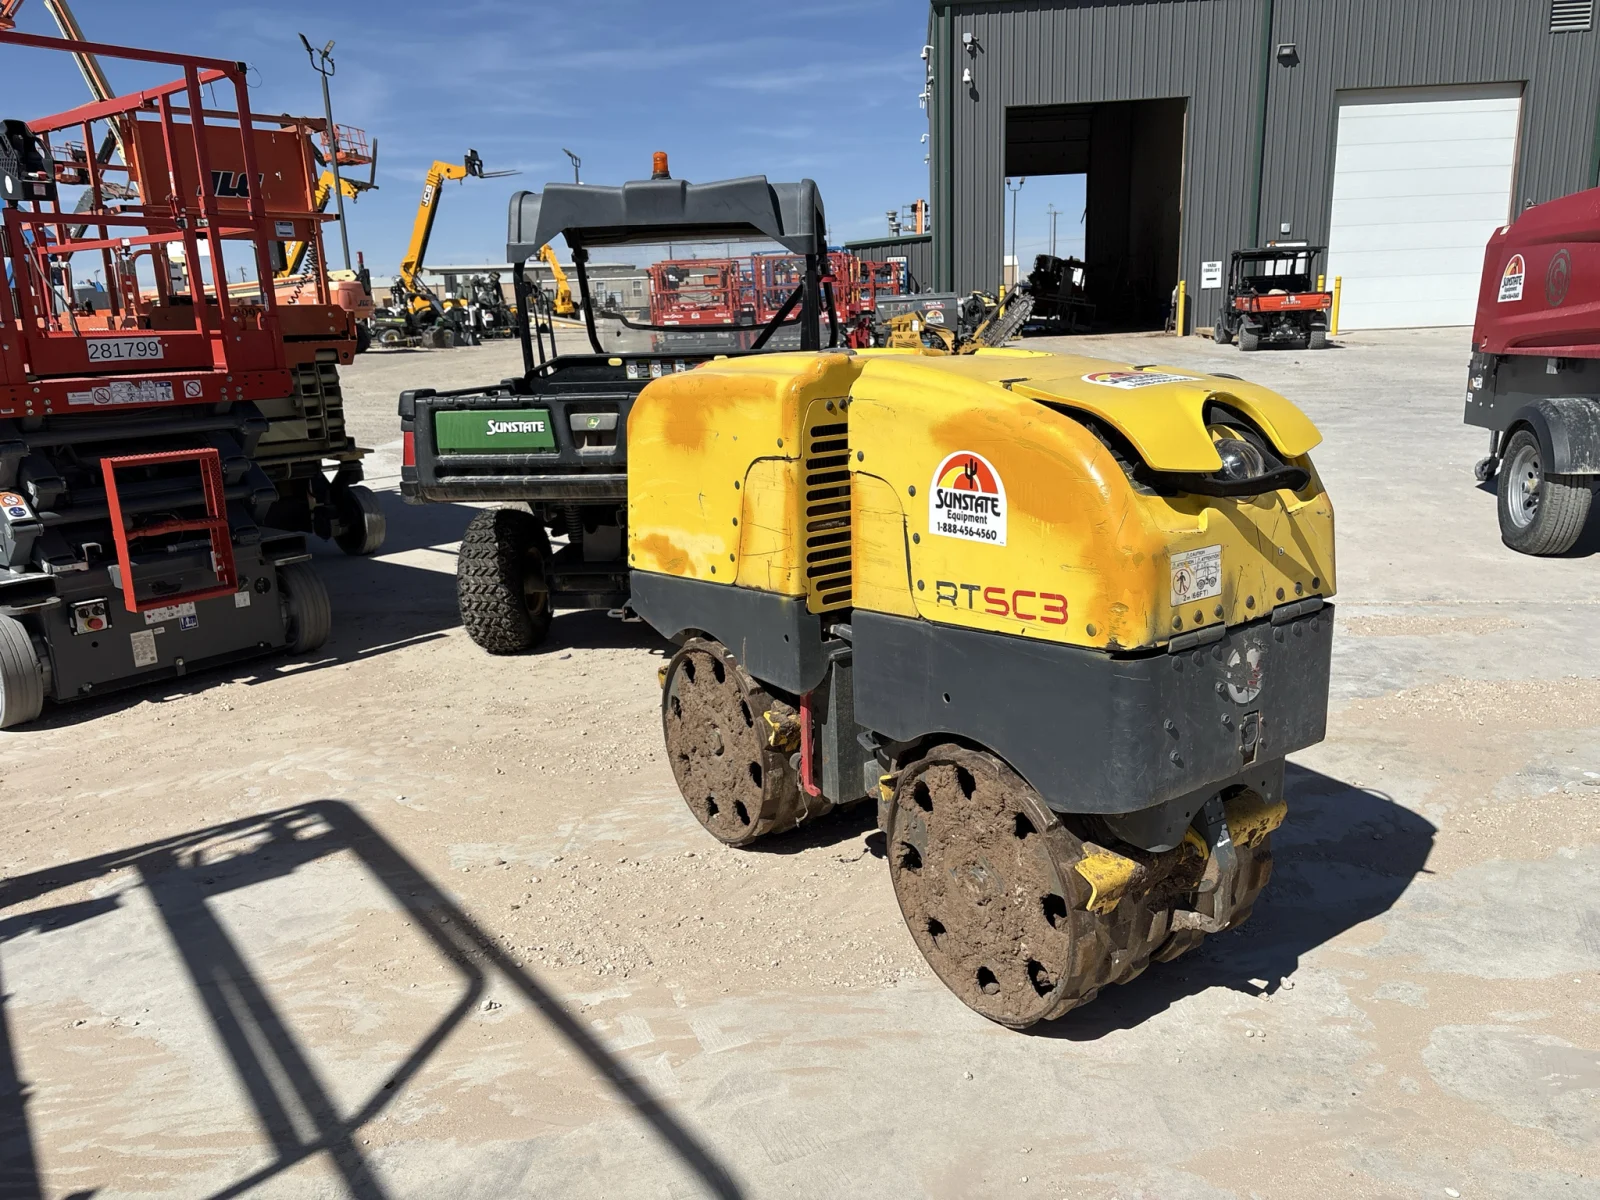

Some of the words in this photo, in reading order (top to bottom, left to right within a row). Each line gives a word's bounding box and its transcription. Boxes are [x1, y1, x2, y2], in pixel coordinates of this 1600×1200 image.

[421, 184, 433, 207] JCB
[88, 341, 159, 359] 281799
[486, 420, 545, 435] SUNSTATE
[935, 488, 1001, 517] SUNSTATE
[947, 509, 988, 524] Equipment
[937, 522, 997, 540] 1-888-456-4560
[936, 580, 1069, 625] RTSC3
